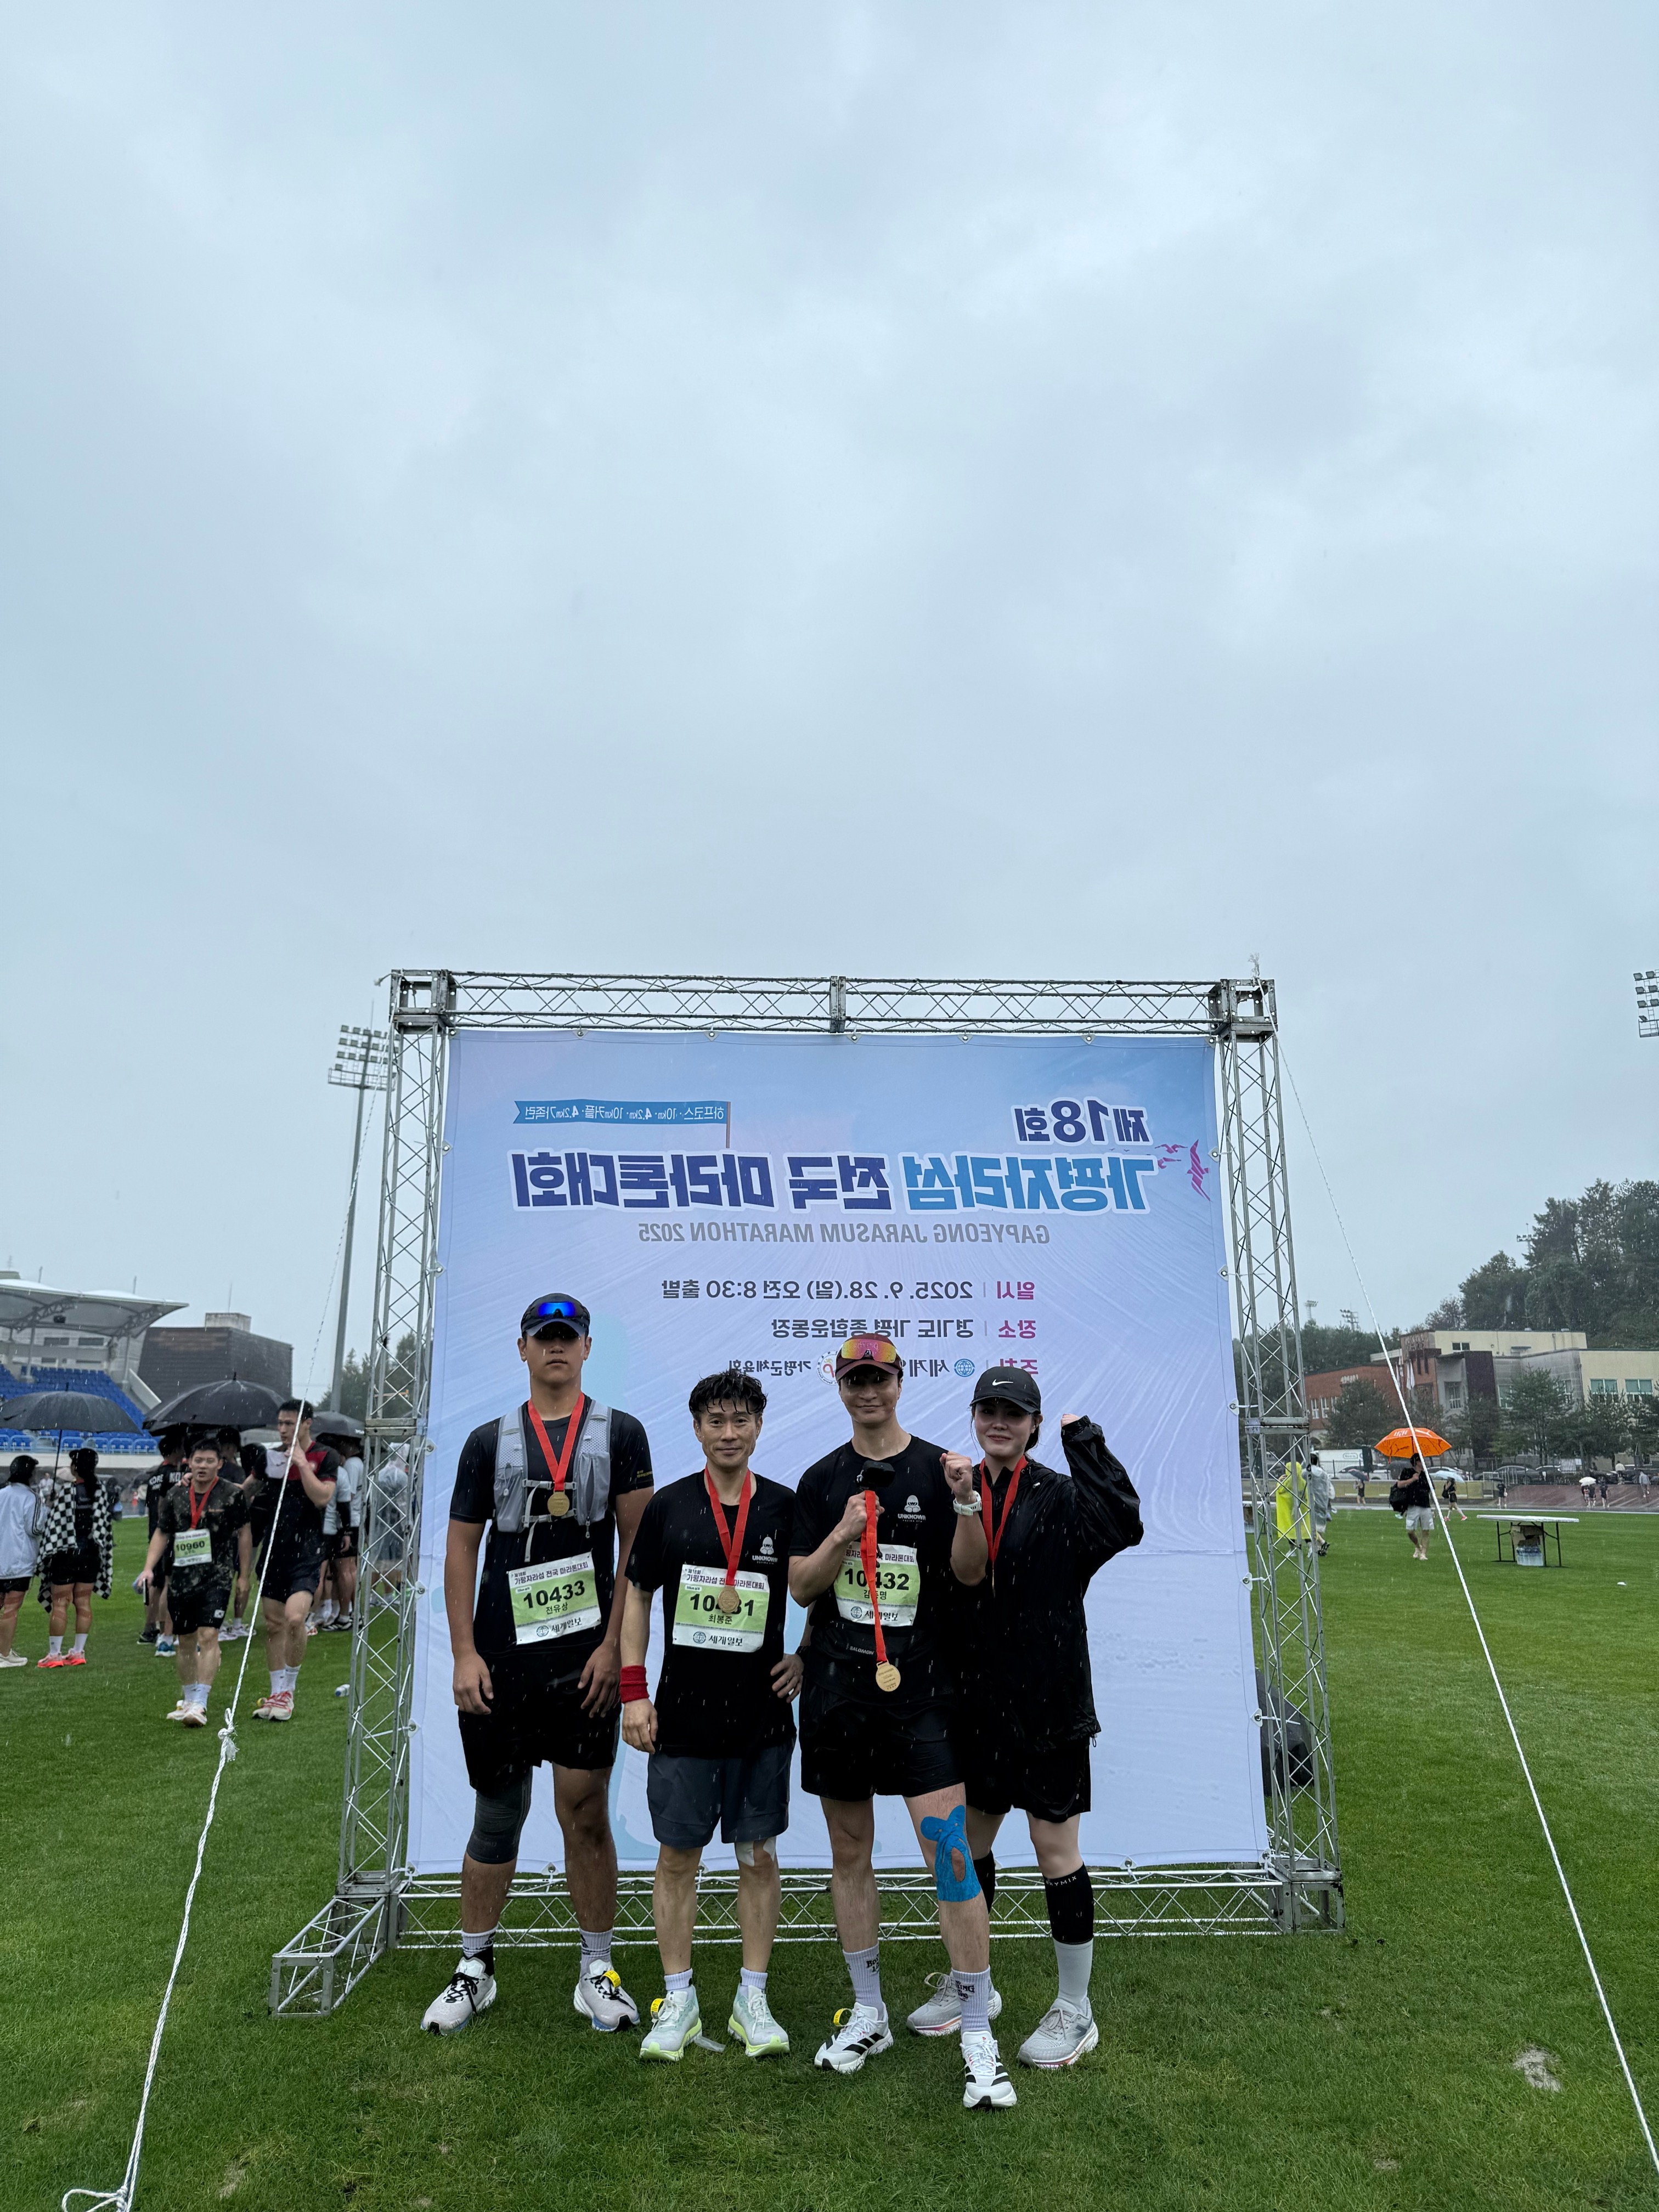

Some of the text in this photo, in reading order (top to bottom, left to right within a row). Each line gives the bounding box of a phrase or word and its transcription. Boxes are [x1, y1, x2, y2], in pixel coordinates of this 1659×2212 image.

[546, 1568, 558, 1578] 전국
[560, 1561, 589, 1575] 마라톤대회
[686, 1574, 718, 1584] 가평자라섬
[523, 1580, 585, 1609] 10433
[546, 1602, 568, 1615] 전유상
[690, 1593, 754, 1616] 101
[551, 1617, 583, 1633] 세계일보
[708, 1614, 733, 1625] 최봉준
[708, 1635, 743, 1646] 세계일보
[849, 1646, 874, 1655] SALOMON
